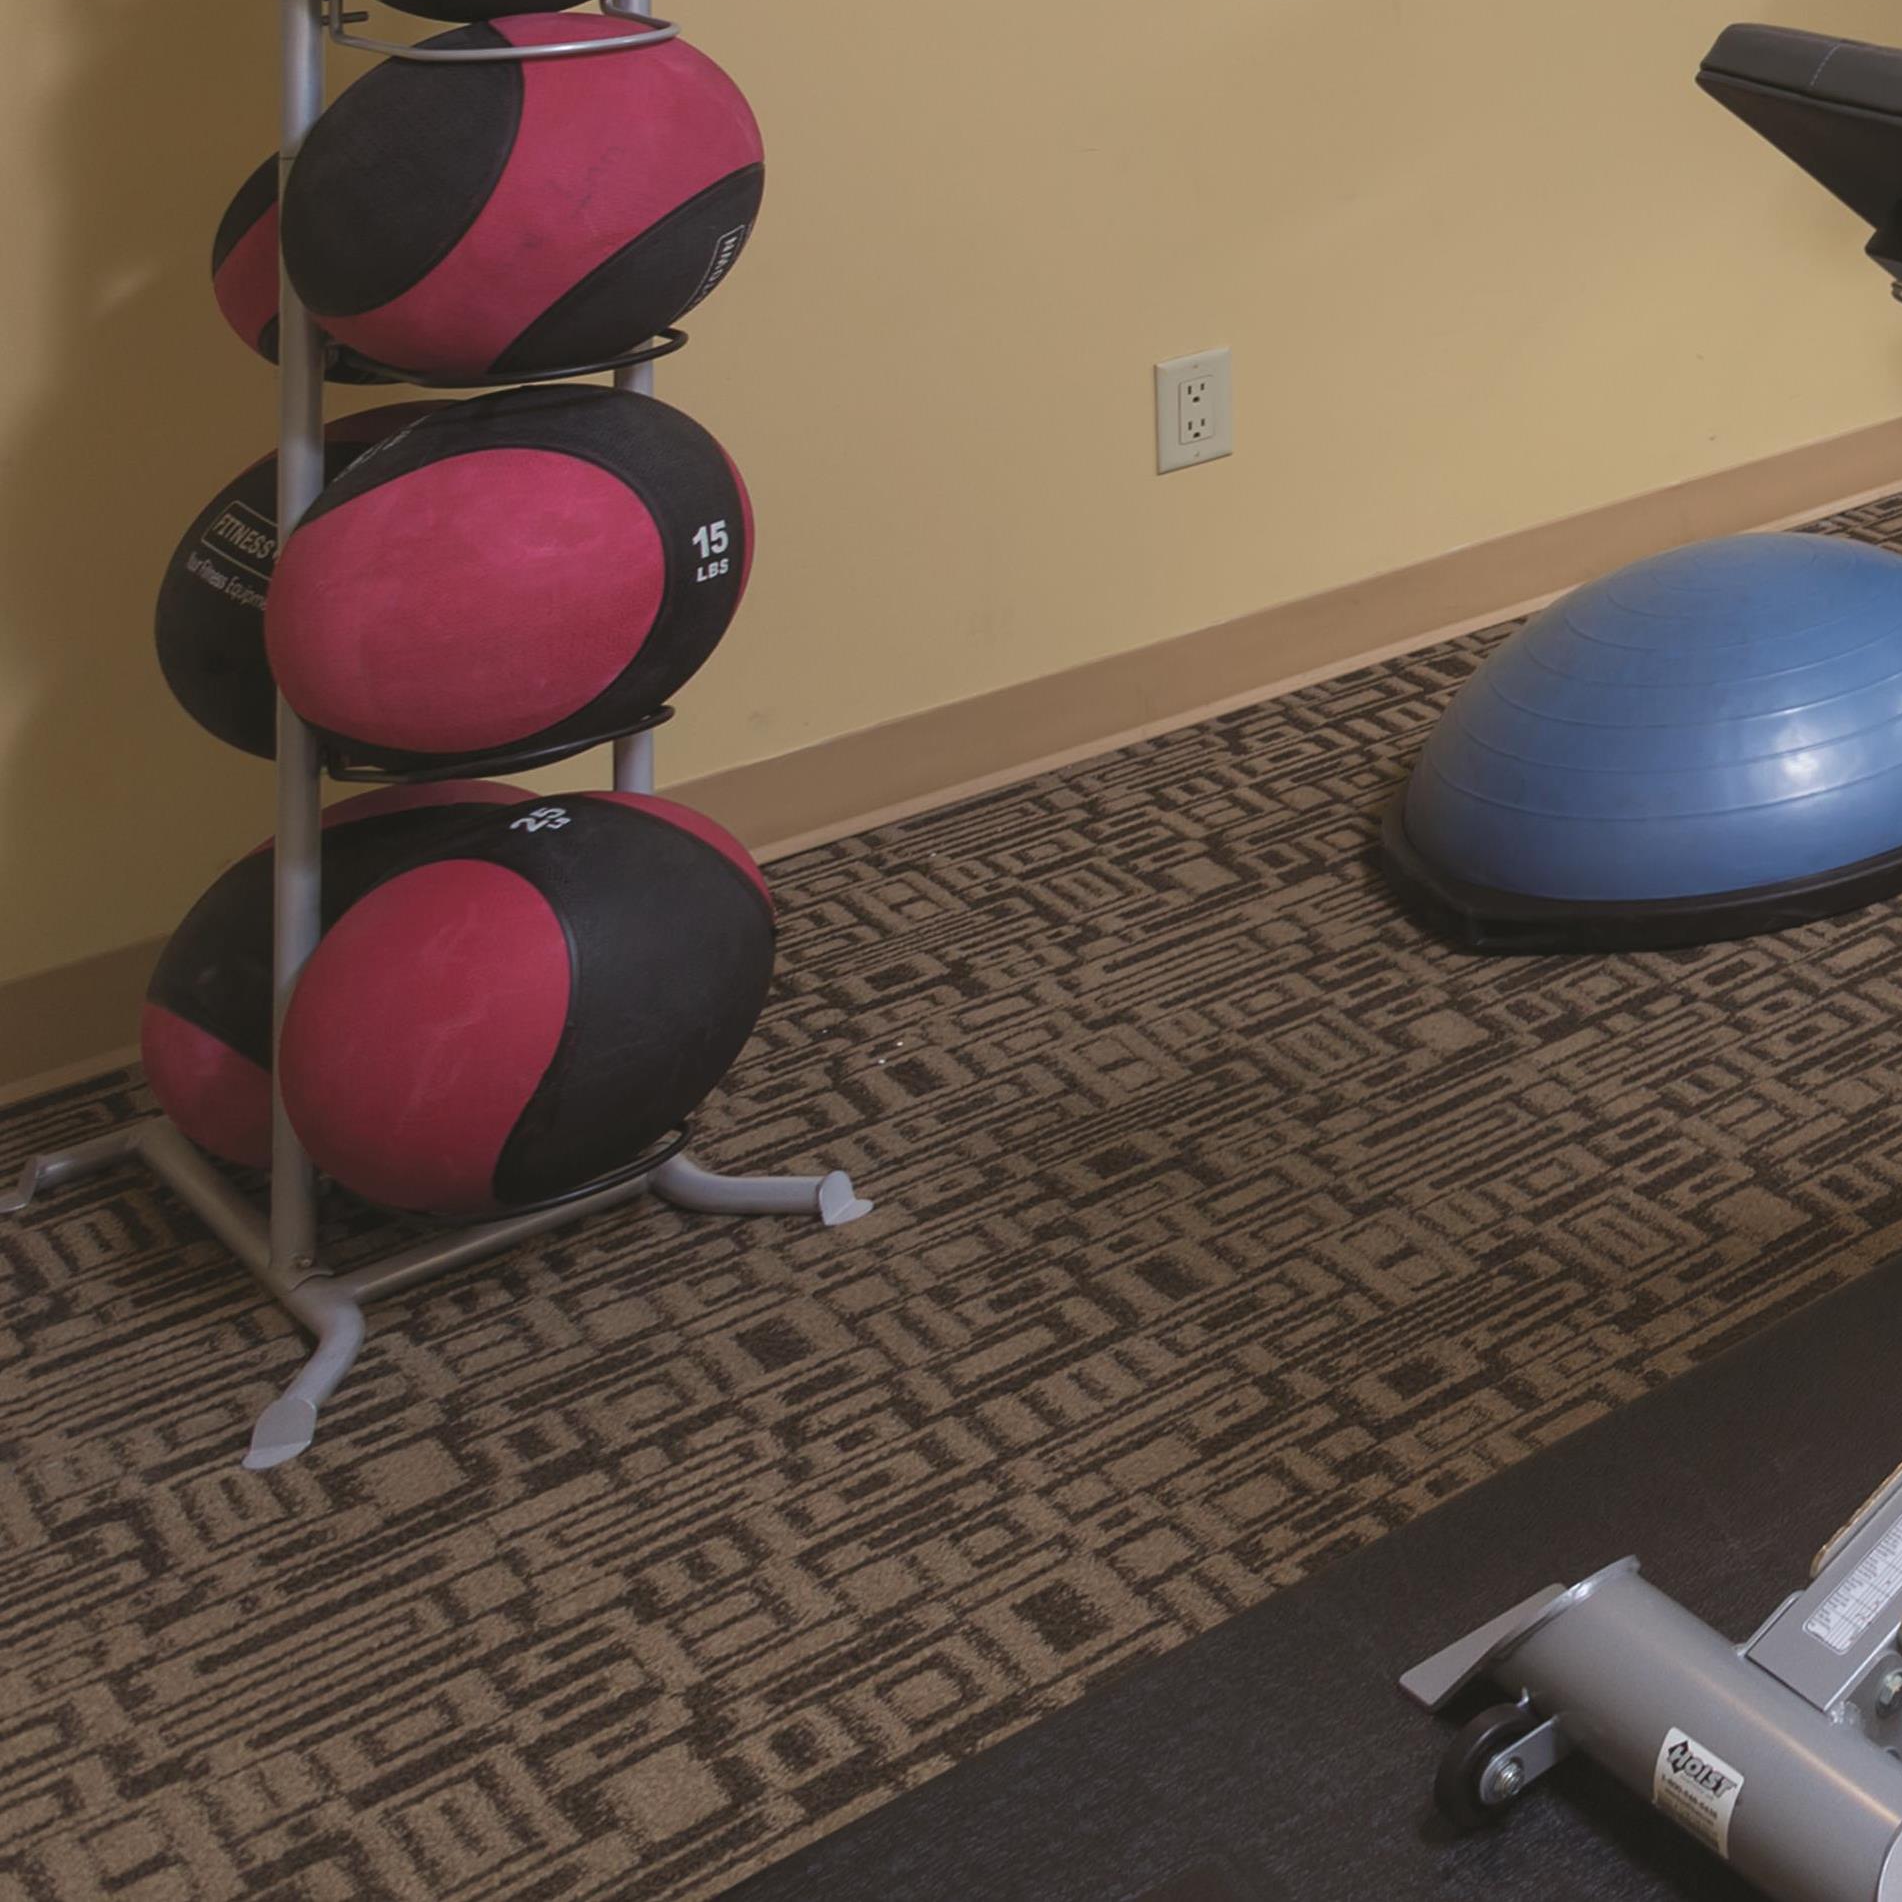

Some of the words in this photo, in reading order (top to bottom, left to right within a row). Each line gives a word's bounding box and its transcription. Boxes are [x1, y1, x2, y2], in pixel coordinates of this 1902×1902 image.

[212, 513, 275, 560] FITNESS
[692, 519, 729, 558] 15
[696, 558, 729, 583] LBS
[509, 807, 567, 832] 25
[1667, 1742, 1738, 1799] HOIST
